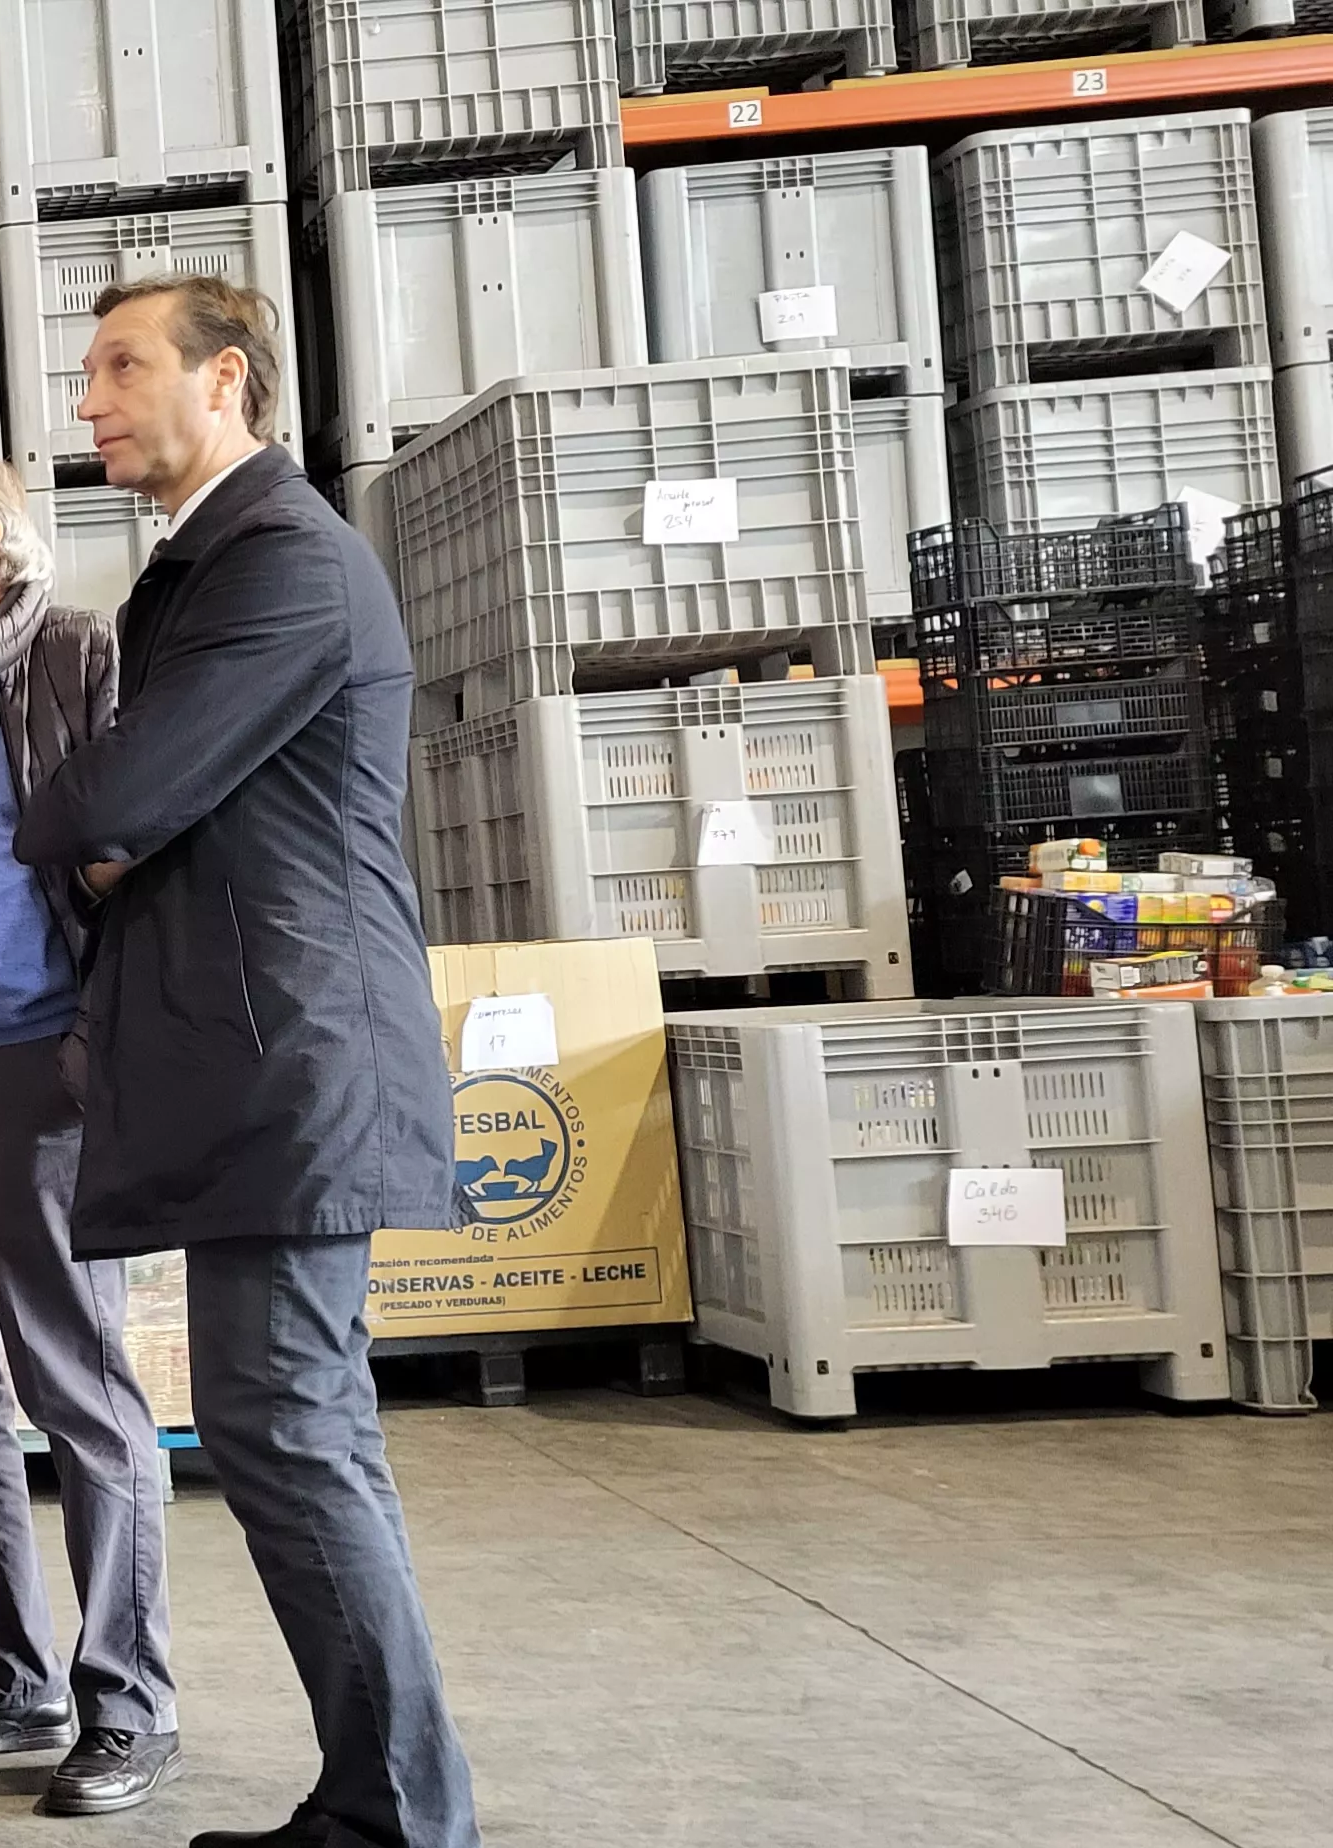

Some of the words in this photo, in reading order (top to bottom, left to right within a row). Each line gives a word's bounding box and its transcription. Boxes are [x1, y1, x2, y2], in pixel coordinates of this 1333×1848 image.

[1076, 72, 1104, 92] 23
[732, 103, 759, 123] 22
[489, 1034, 506, 1053] 17
[964, 1178, 1018, 1200] Caldo
[471, 1226, 499, 1243] DE
[506, 1156, 588, 1243] ALIMENTOS
[370, 1257, 411, 1269] nación
[414, 1253, 495, 1268] recomendada
[368, 1274, 475, 1295] ONSERVAS
[493, 1268, 566, 1289] ACEITE
[582, 1262, 647, 1283] LECHE
[380, 1298, 433, 1312] (PESCADO
[435, 1298, 443, 1309] Y
[445, 1295, 507, 1309] VERDURAS)
